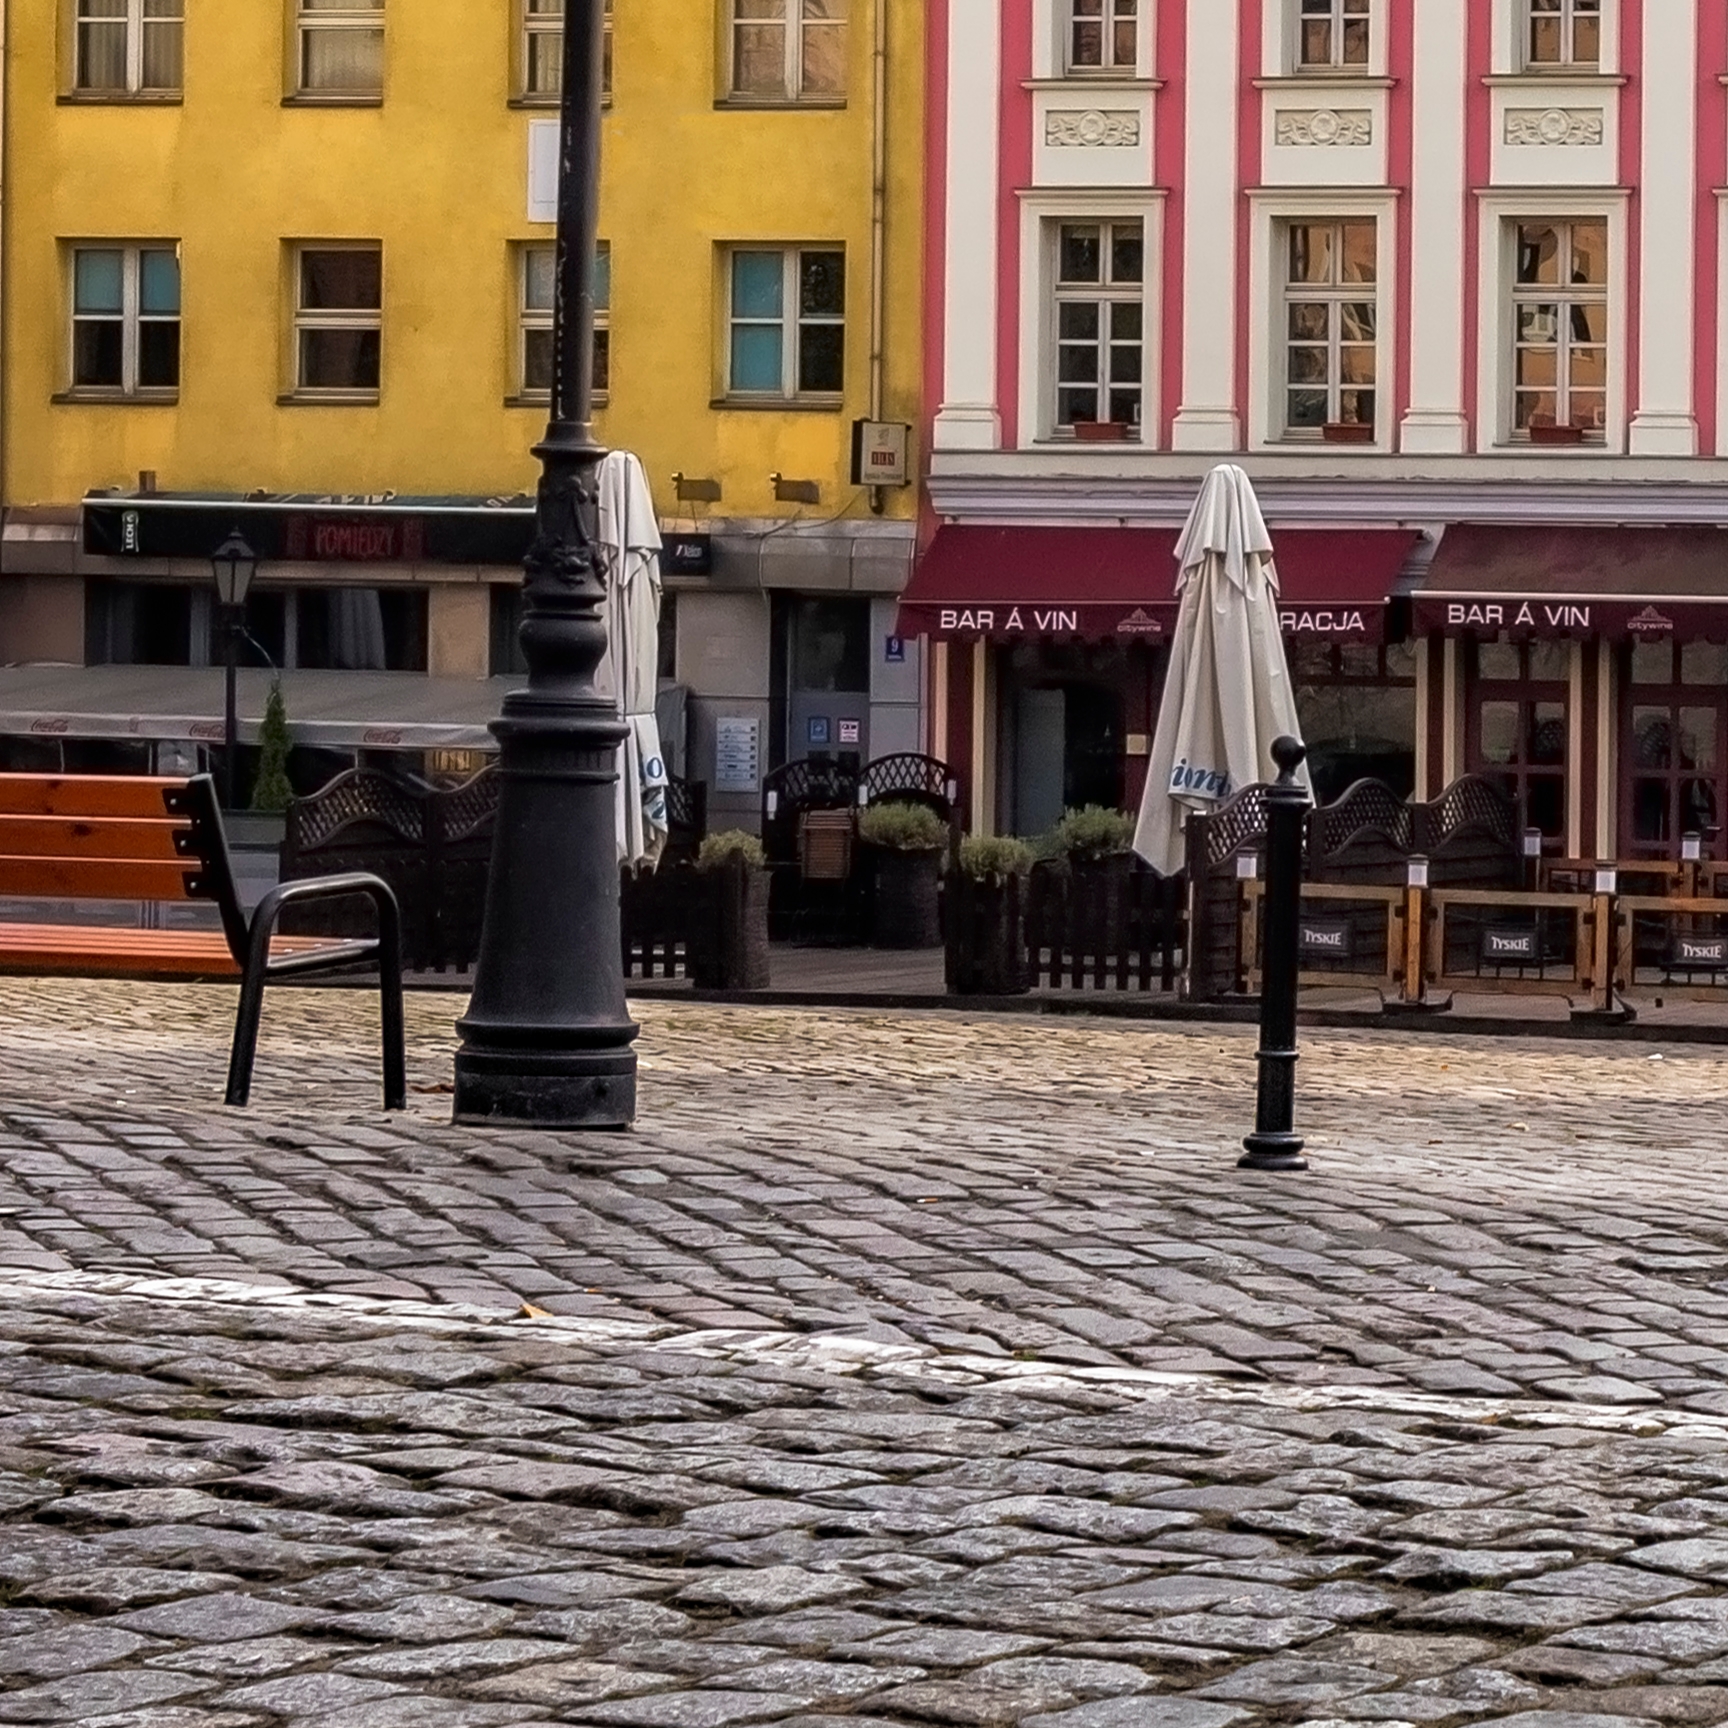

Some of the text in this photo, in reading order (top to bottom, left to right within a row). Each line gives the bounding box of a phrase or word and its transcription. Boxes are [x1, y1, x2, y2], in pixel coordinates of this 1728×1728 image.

[940, 610, 994, 629] BAR
[1034, 610, 1077, 630] VIN
[1448, 604, 1502, 624] BAR
[1544, 605, 1590, 627] VIN
[891, 638, 899, 653] 9
[1303, 928, 1342, 946] TYSKIE
[1491, 935, 1530, 952] TYSKIE
[1682, 943, 1722, 959] TYSKIE
